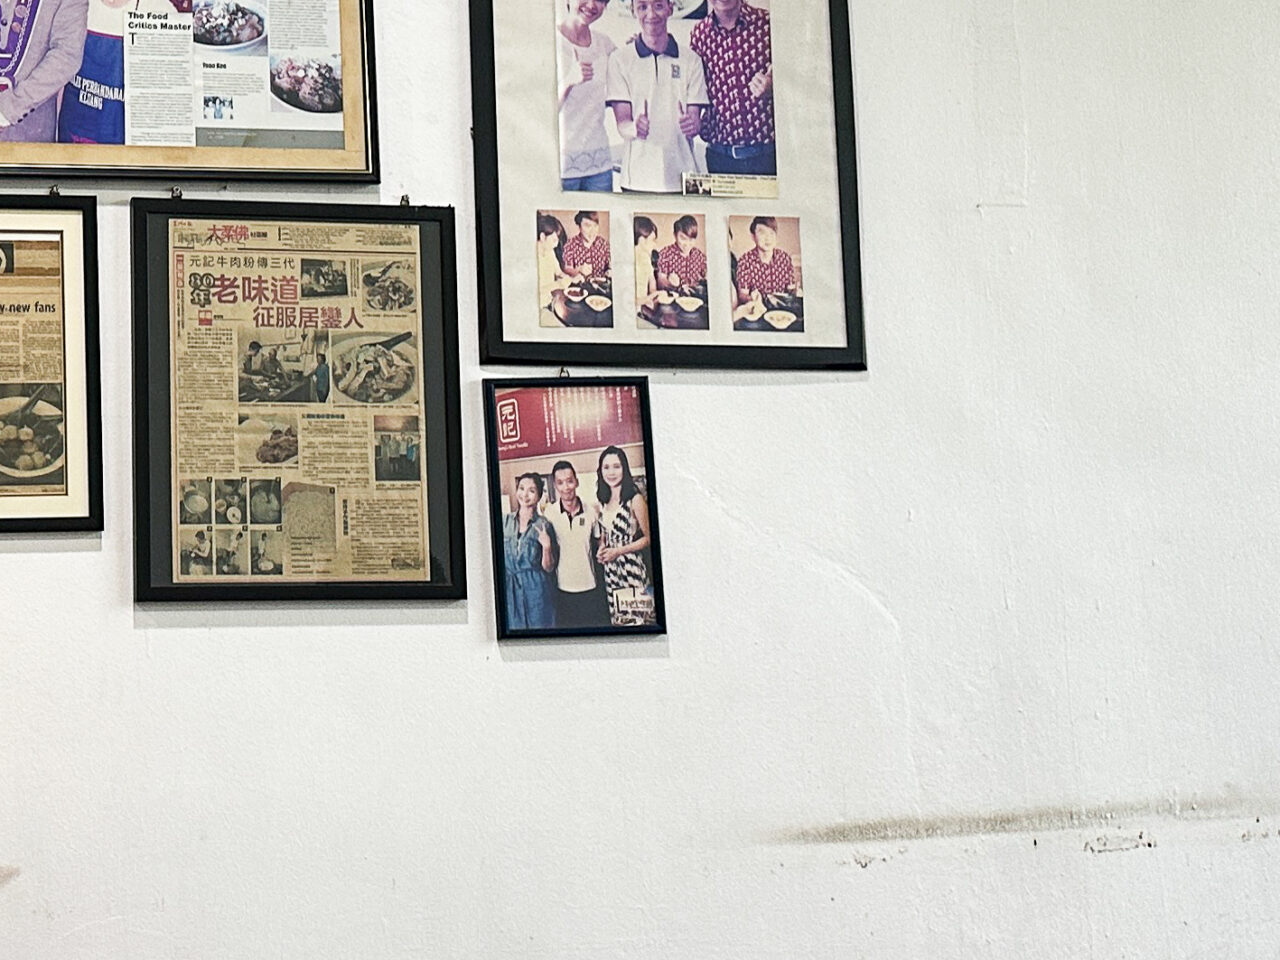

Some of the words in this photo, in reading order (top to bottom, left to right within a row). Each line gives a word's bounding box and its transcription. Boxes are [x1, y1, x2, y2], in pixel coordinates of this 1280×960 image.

[147, 12, 169, 21] Food
[160, 23, 192, 32] Master
[189, 255, 296, 270] 元記牛肉粉傳三代
[212, 274, 300, 305] 老味道
[8, 303, 31, 313] new
[34, 301, 56, 313] fans
[253, 306, 365, 330] 征服居鑾人
